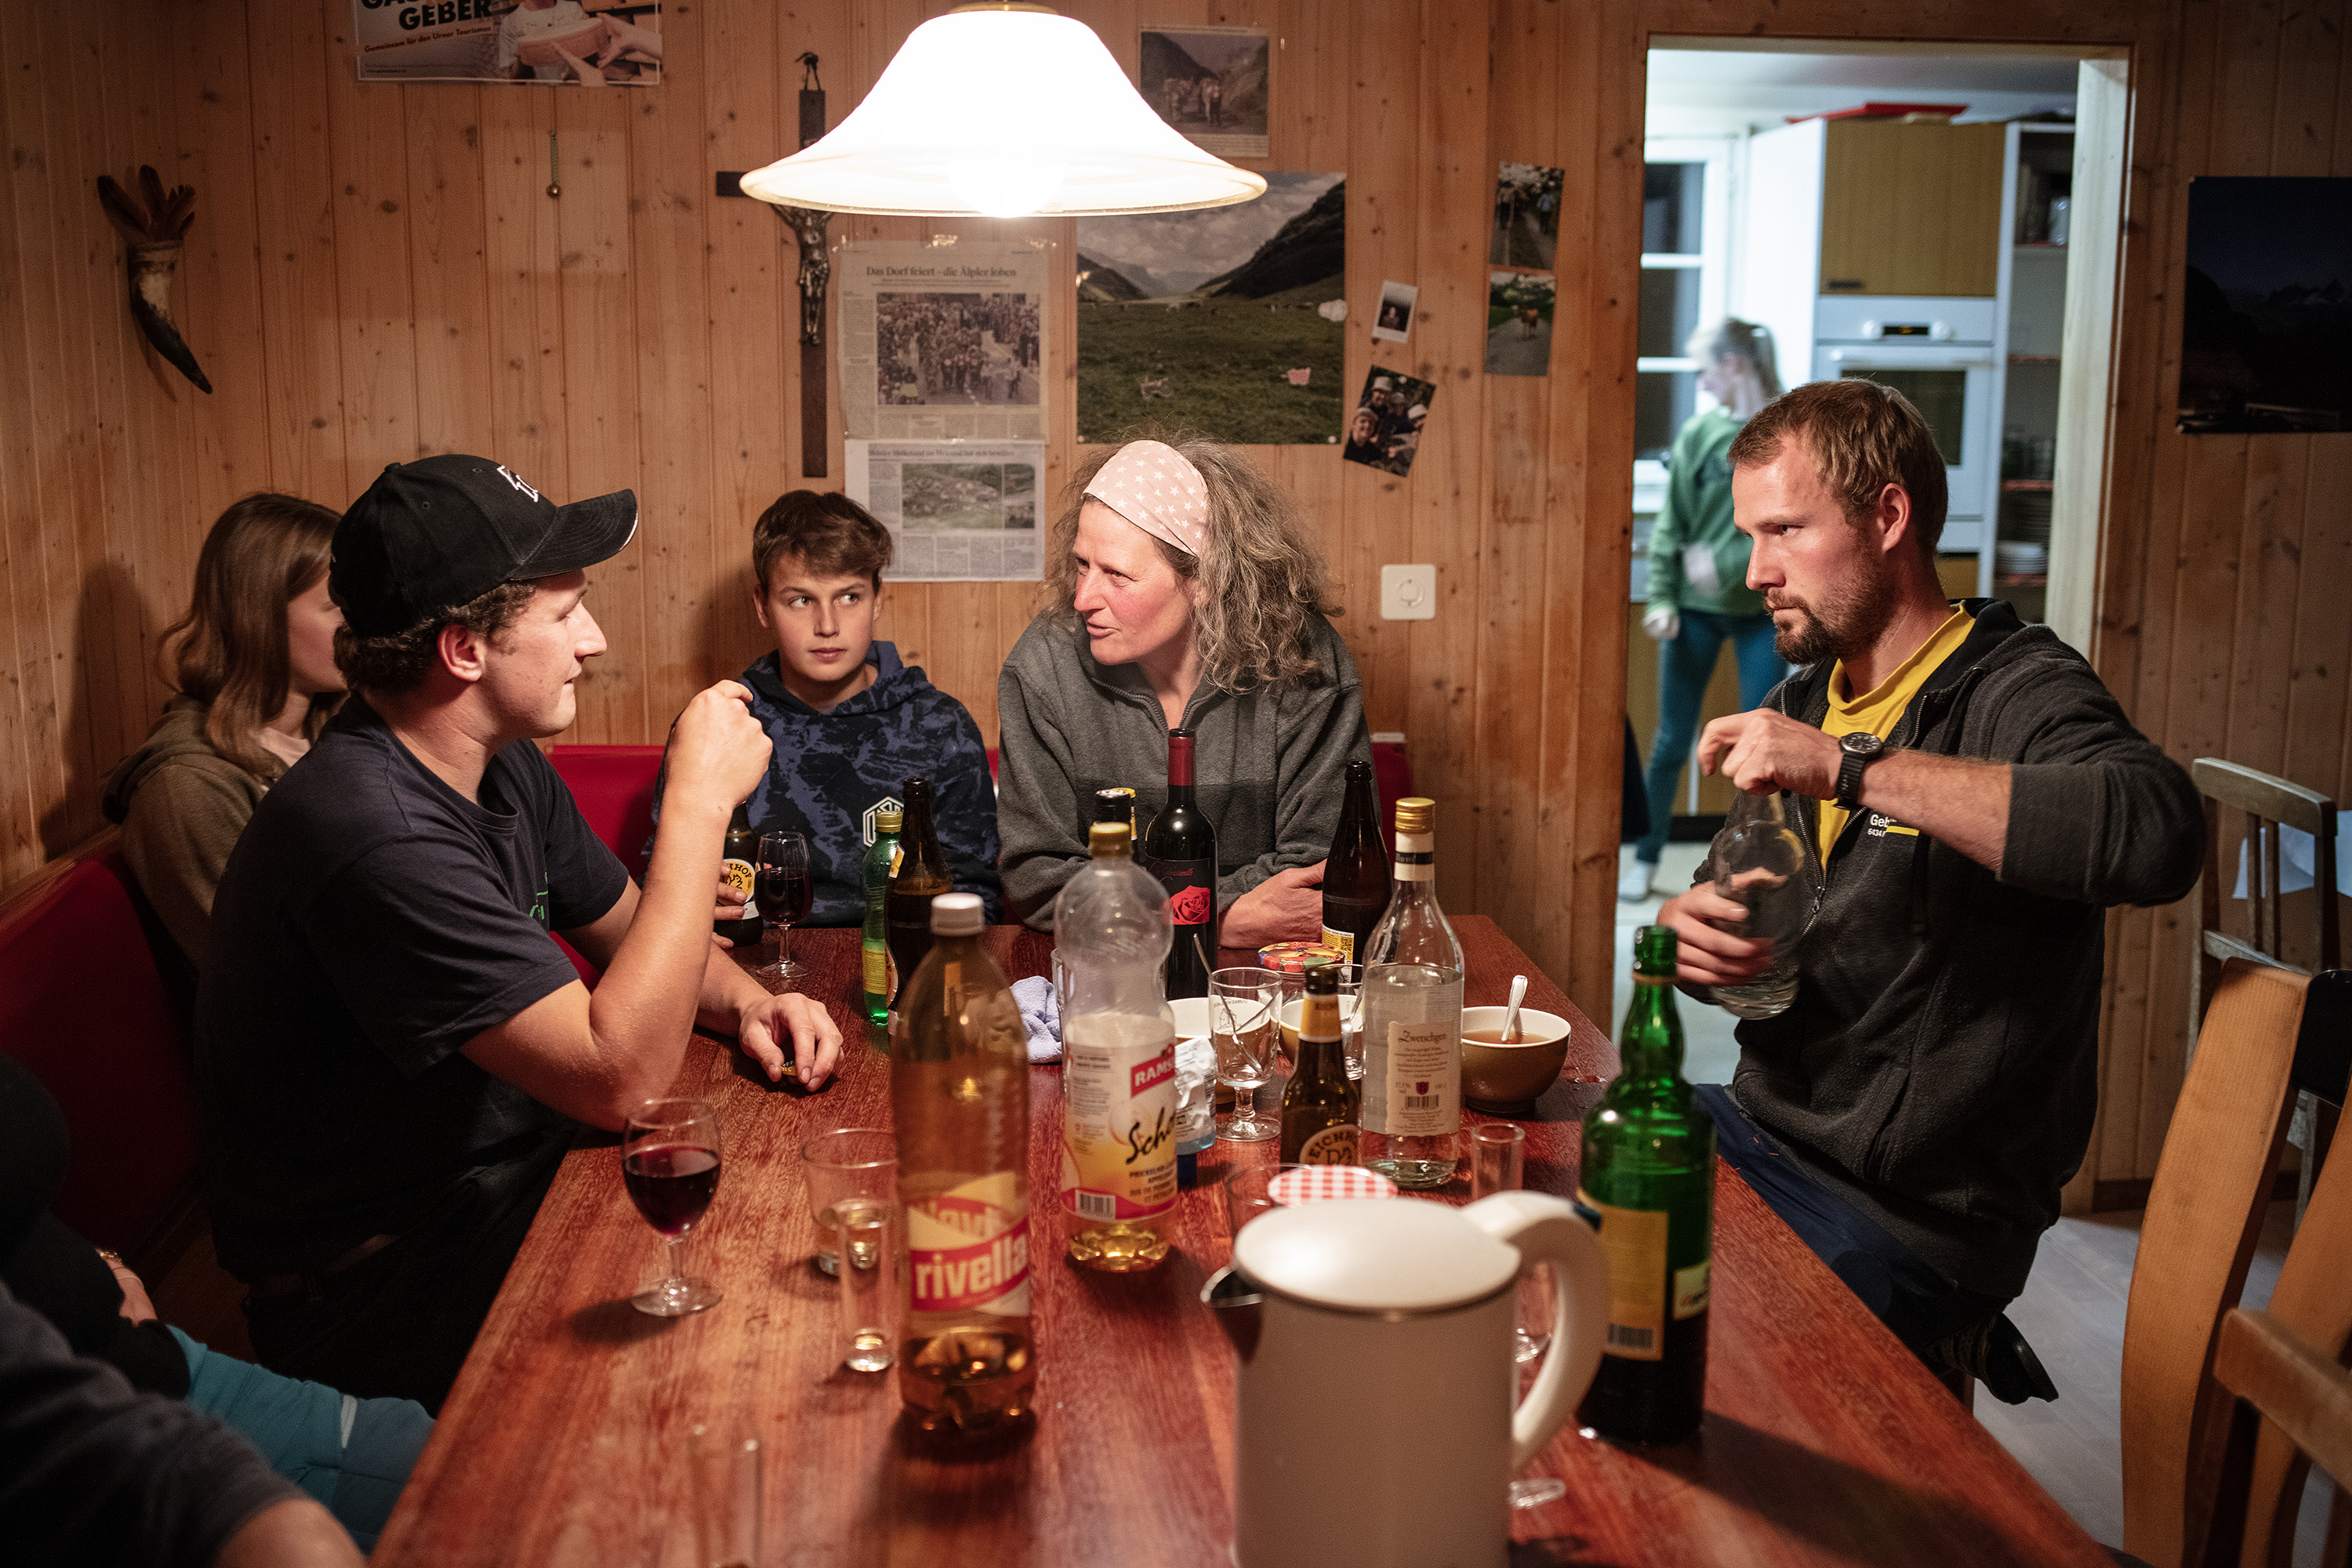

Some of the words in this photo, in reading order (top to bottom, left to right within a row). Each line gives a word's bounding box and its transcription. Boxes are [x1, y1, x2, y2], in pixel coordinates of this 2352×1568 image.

[399, 0, 492, 30] GEBER
[364, 40, 405, 53] Gemeinsam
[406, 37, 416, 45] für
[456, 25, 492, 35] Tourismus
[866, 267, 884, 275] Das
[885, 266, 909, 275] Dorf
[909, 266, 935, 275] feiert
[943, 267, 957, 275] die
[1134, 1056, 1175, 1087] RAMS
[1126, 1106, 1175, 1165] Scho
[916, 1233, 1027, 1300] rivella
